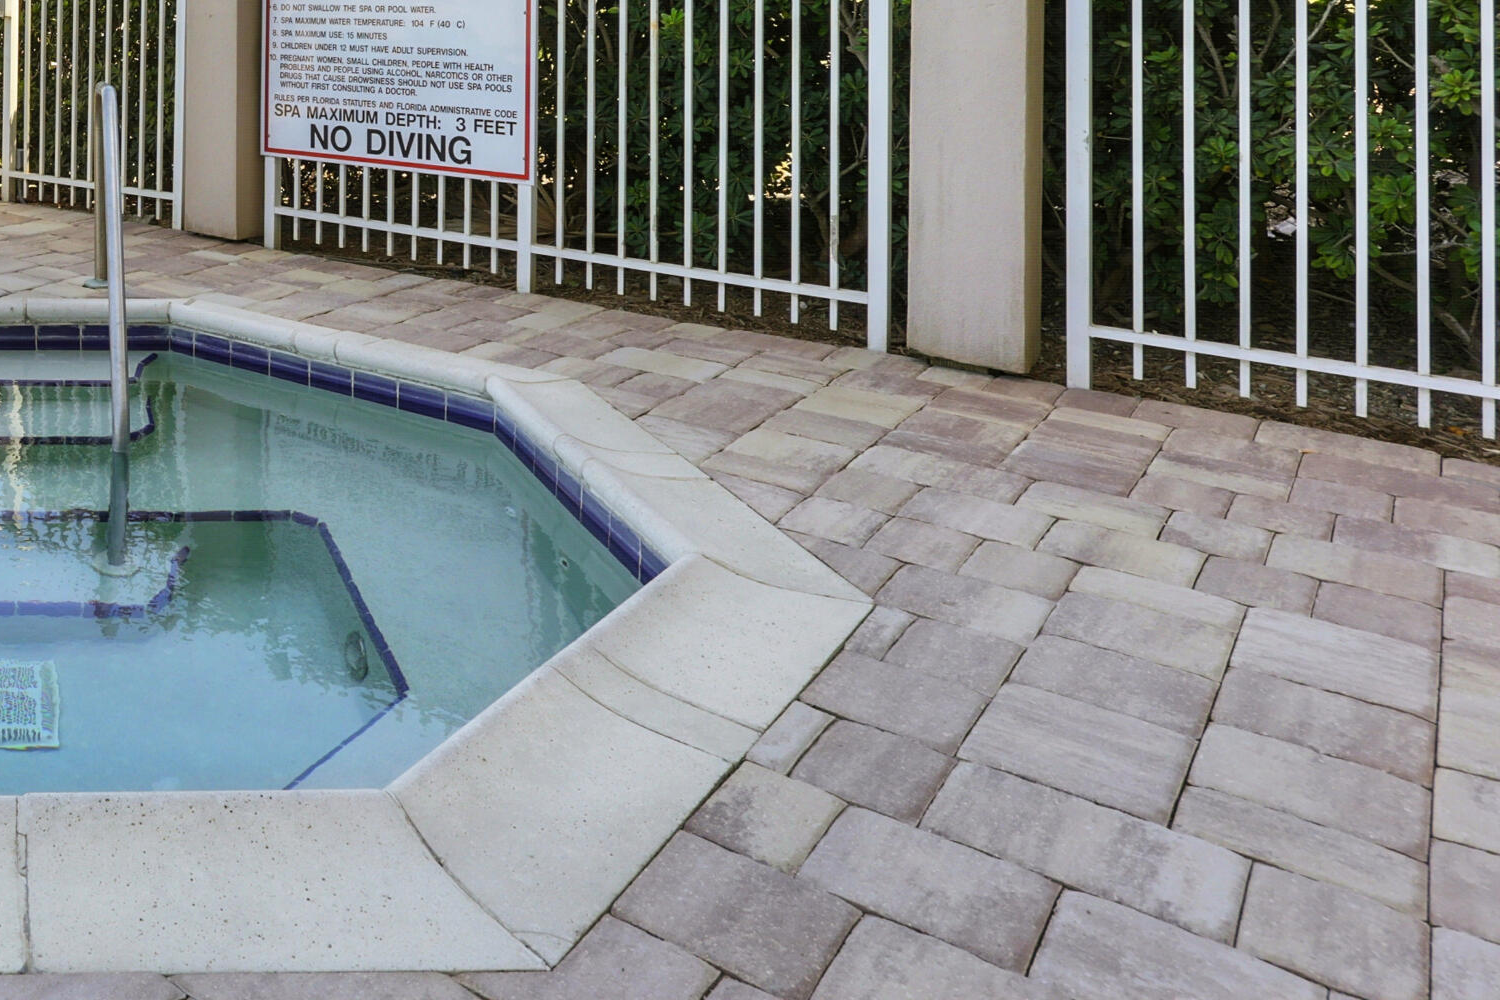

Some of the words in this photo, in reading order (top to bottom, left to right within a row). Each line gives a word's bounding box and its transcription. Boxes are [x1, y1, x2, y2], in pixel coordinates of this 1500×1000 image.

[280, 3, 290, 11] DO
[292, 3, 305, 12] NOT
[307, 3, 341, 12] SWALLOW
[342, 4, 356, 12] THE
[358, 4, 372, 13] SPA
[374, 4, 385, 13] OR
[387, 4, 408, 13] POOL
[409, 5, 436, 14] WATER.
[280, 16, 292, 24] SPA
[294, 16, 326, 25] MAXIMUM
[328, 17, 351, 26] WATER
[280, 28, 293, 37] SPA
[294, 29, 326, 38] MAXIMUM
[346, 31, 354, 39] 15
[356, 31, 387, 40] MINUTES
[280, 41, 312, 50] CHILDREN
[314, 42, 337, 51] UNDER
[339, 43, 347, 52] 12
[348, 43, 368, 53] MUST
[370, 44, 389, 54] HAVE
[391, 45, 414, 55] ADULT
[416, 46, 468, 57] SUPERVISION.
[279, 53, 314, 63] PREGNANT
[346, 56, 369, 66] SMALL
[411, 59, 440, 69] PEOPLE
[442, 61, 462, 70] WITH
[463, 62, 494, 72] HEALTH
[279, 62, 315, 72] PROBLEMS
[317, 64, 331, 73] AND
[333, 65, 359, 74] PEOPLE
[361, 66, 384, 76] USING
[425, 69, 468, 81] NARCOTICS
[471, 72, 483, 81] OR
[485, 73, 513, 83] OTHER
[279, 71, 302, 80] DRUGS
[304, 72, 320, 81] THAT
[322, 73, 345, 83] CAUSE
[348, 74, 395, 86] DROWSINESS
[397, 77, 428, 88] SHOULD
[429, 79, 446, 89] NOT
[448, 80, 464, 90] USE
[466, 81, 482, 91] SPA
[484, 82, 512, 94] POOLS
[279, 79, 309, 90] WITHOUT
[310, 81, 330, 91] FIRST
[331, 83, 375, 94] CONSULTING
[377, 86, 383, 94] A
[385, 86, 417, 97] DOCTOR.
[273, 93, 295, 102] RULES
[296, 94, 310, 103] PER
[311, 95, 340, 105] FLORIDA
[342, 97, 376, 108] STATUTES
[378, 100, 394, 109] AND
[396, 101, 427, 112] FLORIDA
[429, 104, 491, 117] ADMINISTRATIVE
[493, 108, 518, 119] CODE
[274, 102, 301, 118] SPA
[306, 105, 378, 125] MAXIMUM
[384, 111, 441, 130] DEPTH:
[455, 116, 466, 133] 3
[473, 118, 517, 137] FEET
[309, 122, 352, 152] NO
[366, 126, 472, 165] DIVING
